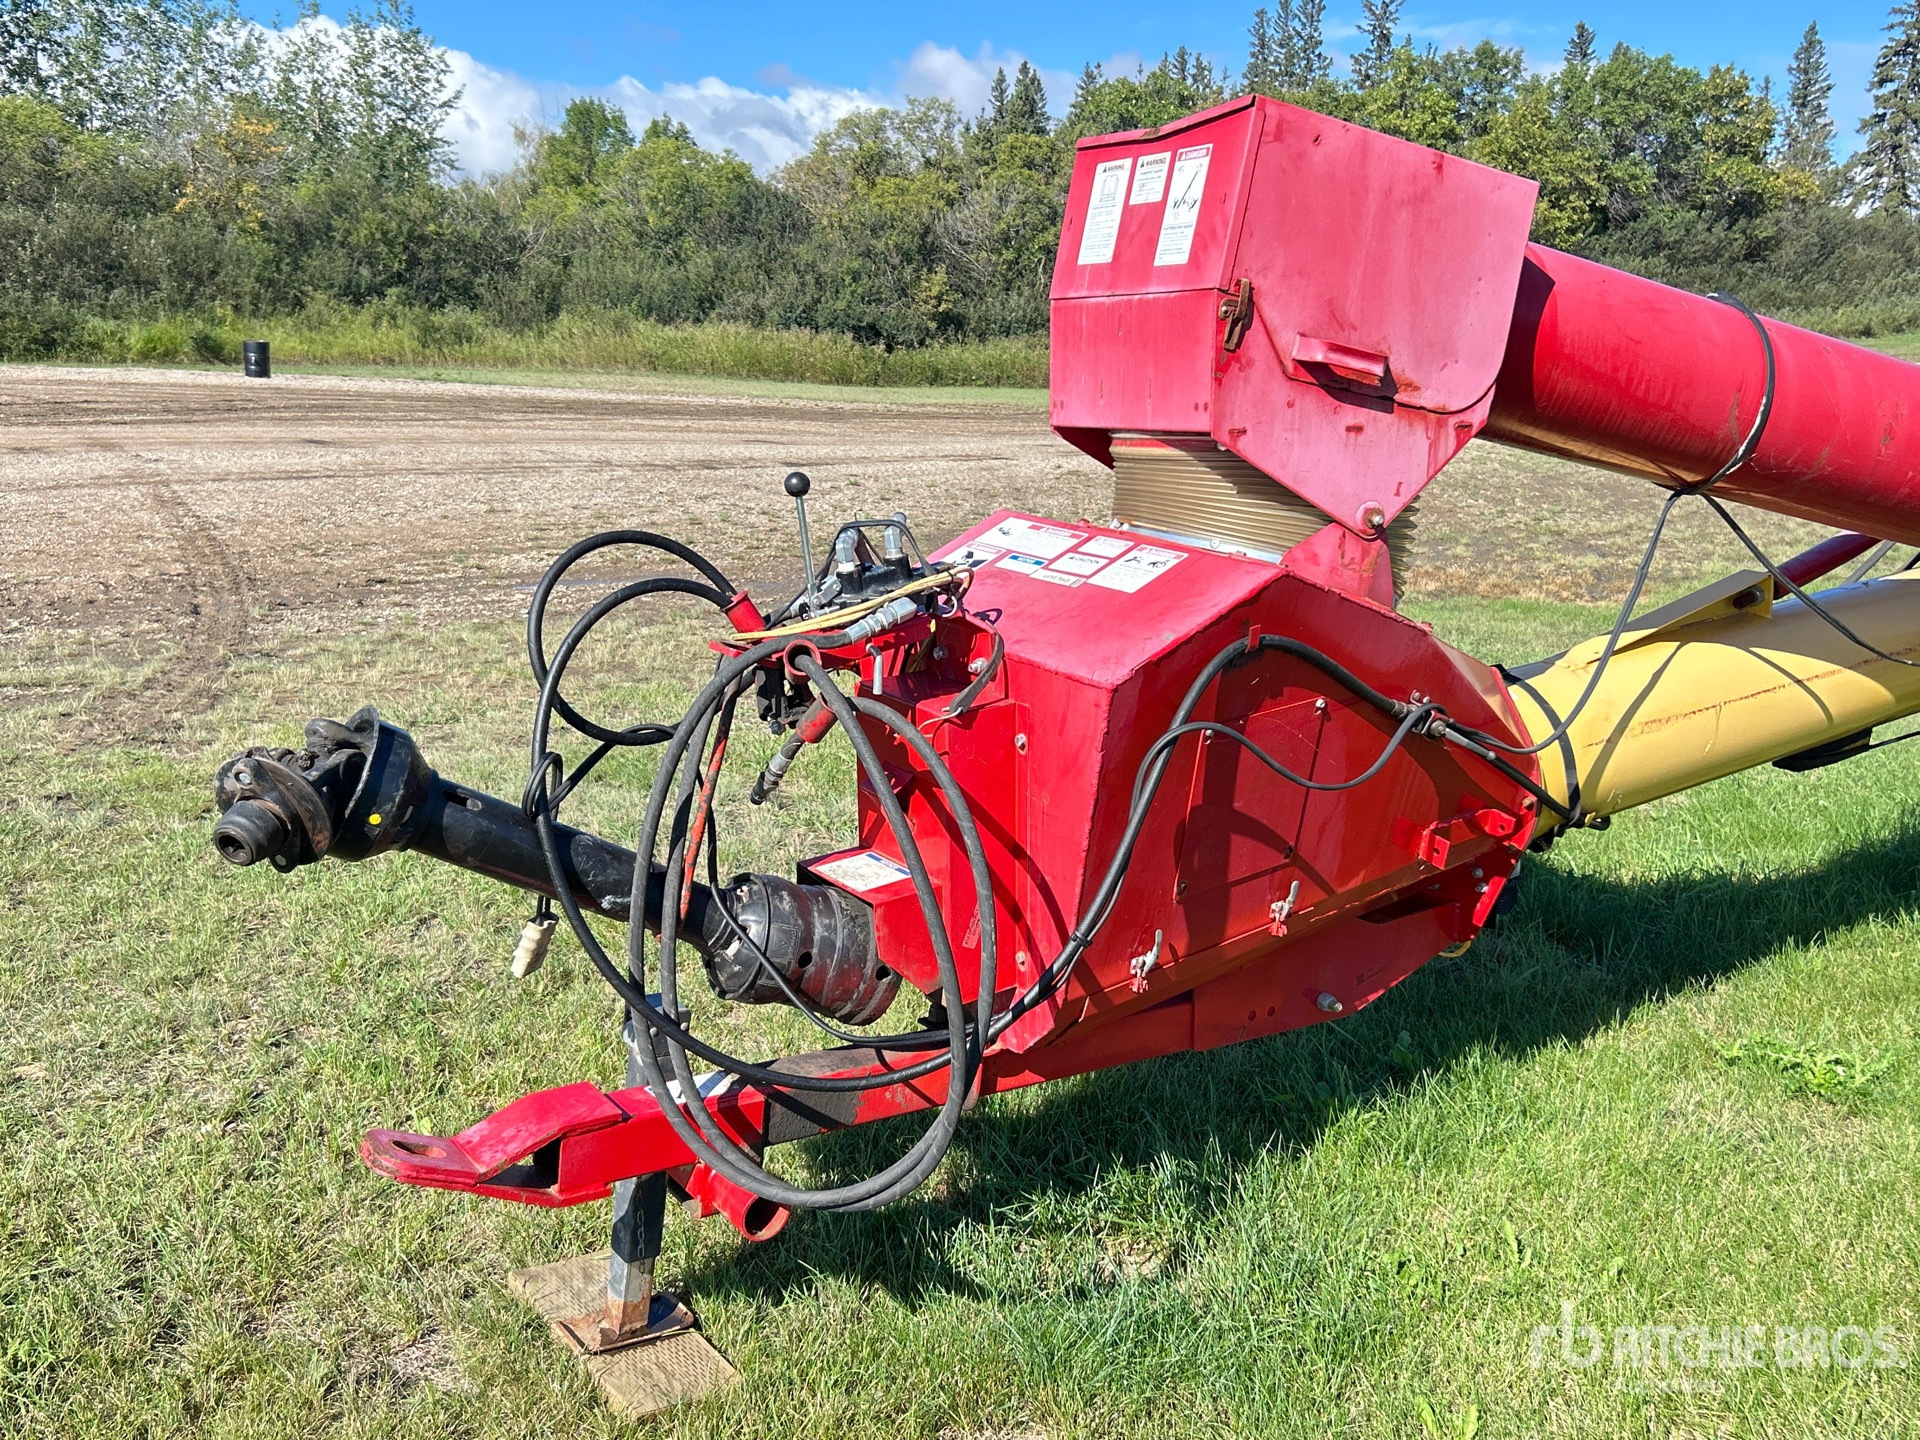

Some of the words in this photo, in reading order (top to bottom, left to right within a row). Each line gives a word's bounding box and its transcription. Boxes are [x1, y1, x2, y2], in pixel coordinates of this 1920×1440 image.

[1186, 148, 1207, 160] DANGER
[1145, 157, 1167, 167] WARNING
[1107, 164, 1125, 172] WARNING
[1074, 556, 1100, 565] CAUTION
